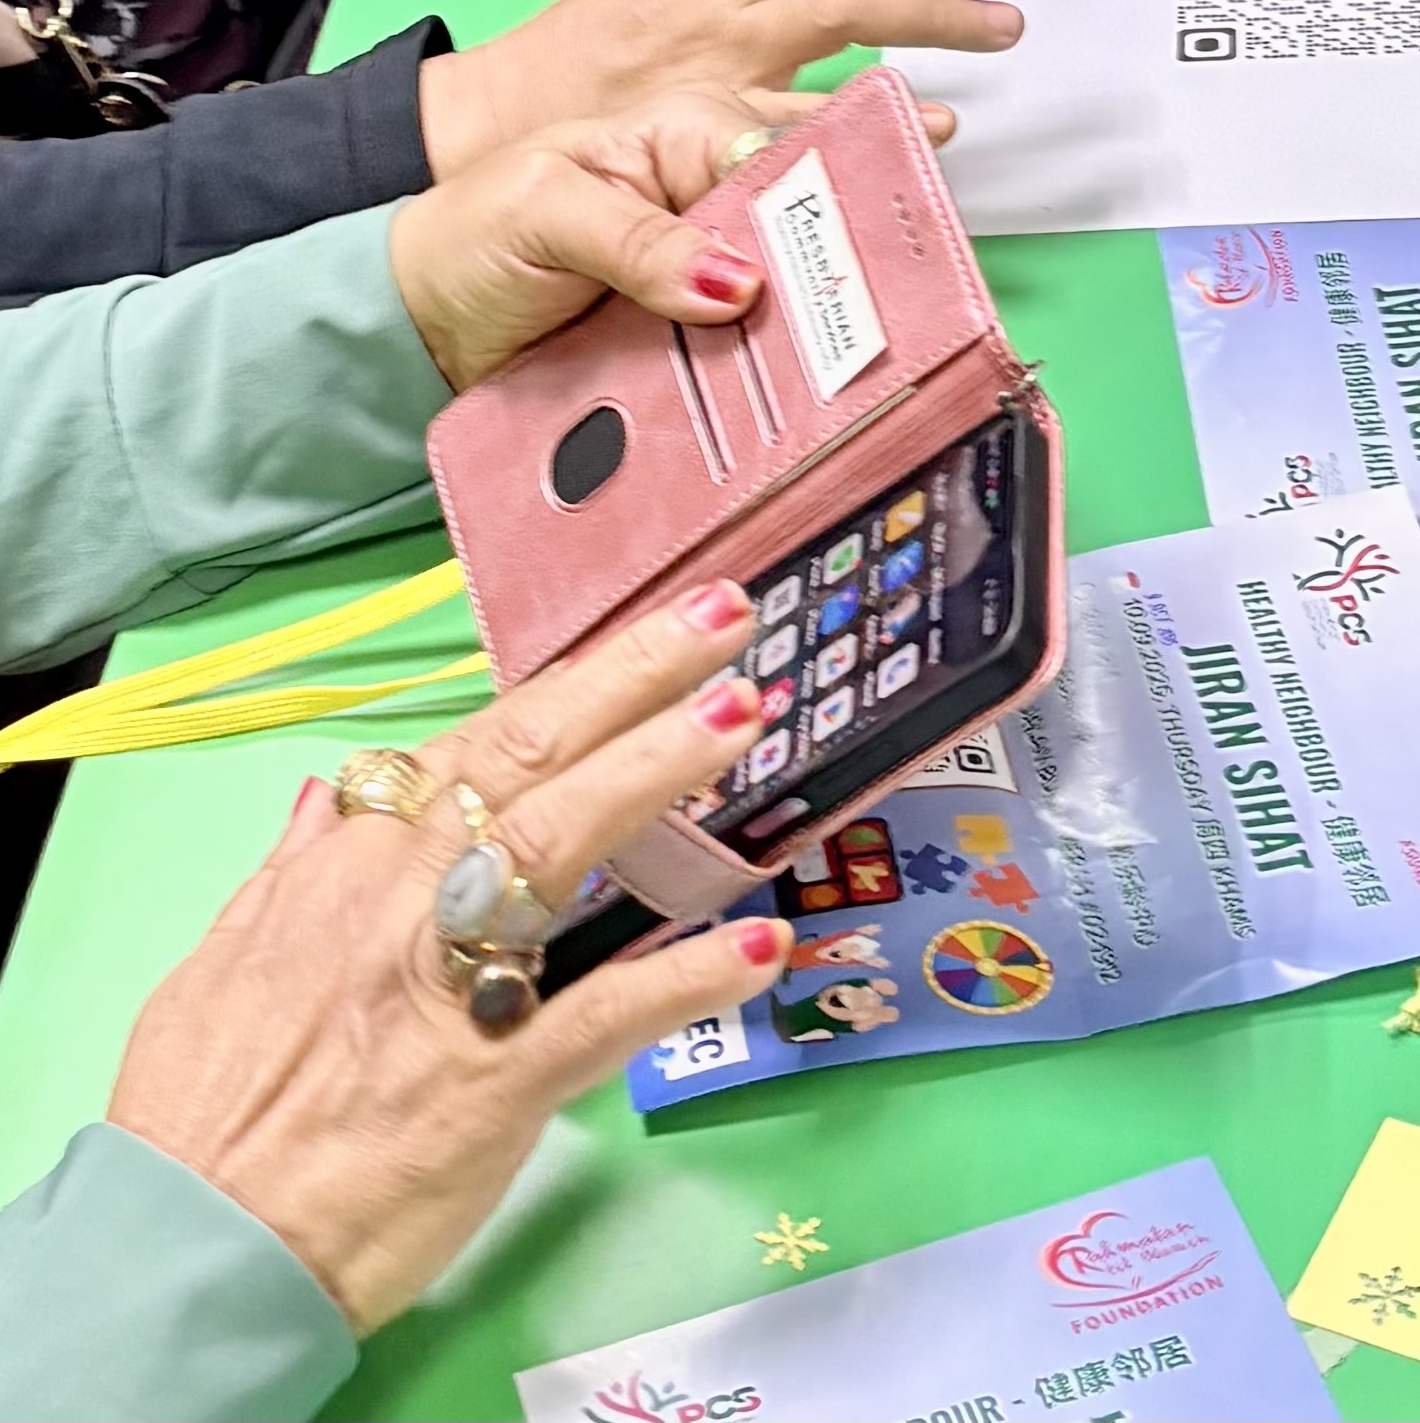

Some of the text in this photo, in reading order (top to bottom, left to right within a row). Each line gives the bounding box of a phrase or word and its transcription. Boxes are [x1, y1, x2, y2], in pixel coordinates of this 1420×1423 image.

[1336, 342, 1390, 438] NEIGHBOUR
[1283, 453, 1320, 500] PCS
[1330, 594, 1373, 647] PCS
[1235, 580, 1296, 666] HEALTHY
[1270, 671, 1344, 794] NEIGHBOUR
[1179, 643, 1316, 873] JIRAN SIHAT
[1156, 703, 1215, 813] THURSDAY
[1213, 865, 1258, 940] KHAMIS
[686, 1016, 725, 1064] EC
[1069, 1275, 1226, 1335] FOUNDATION
[675, 1385, 762, 1423] PCS
[1034, 1334, 1192, 1410] 健康邻居
